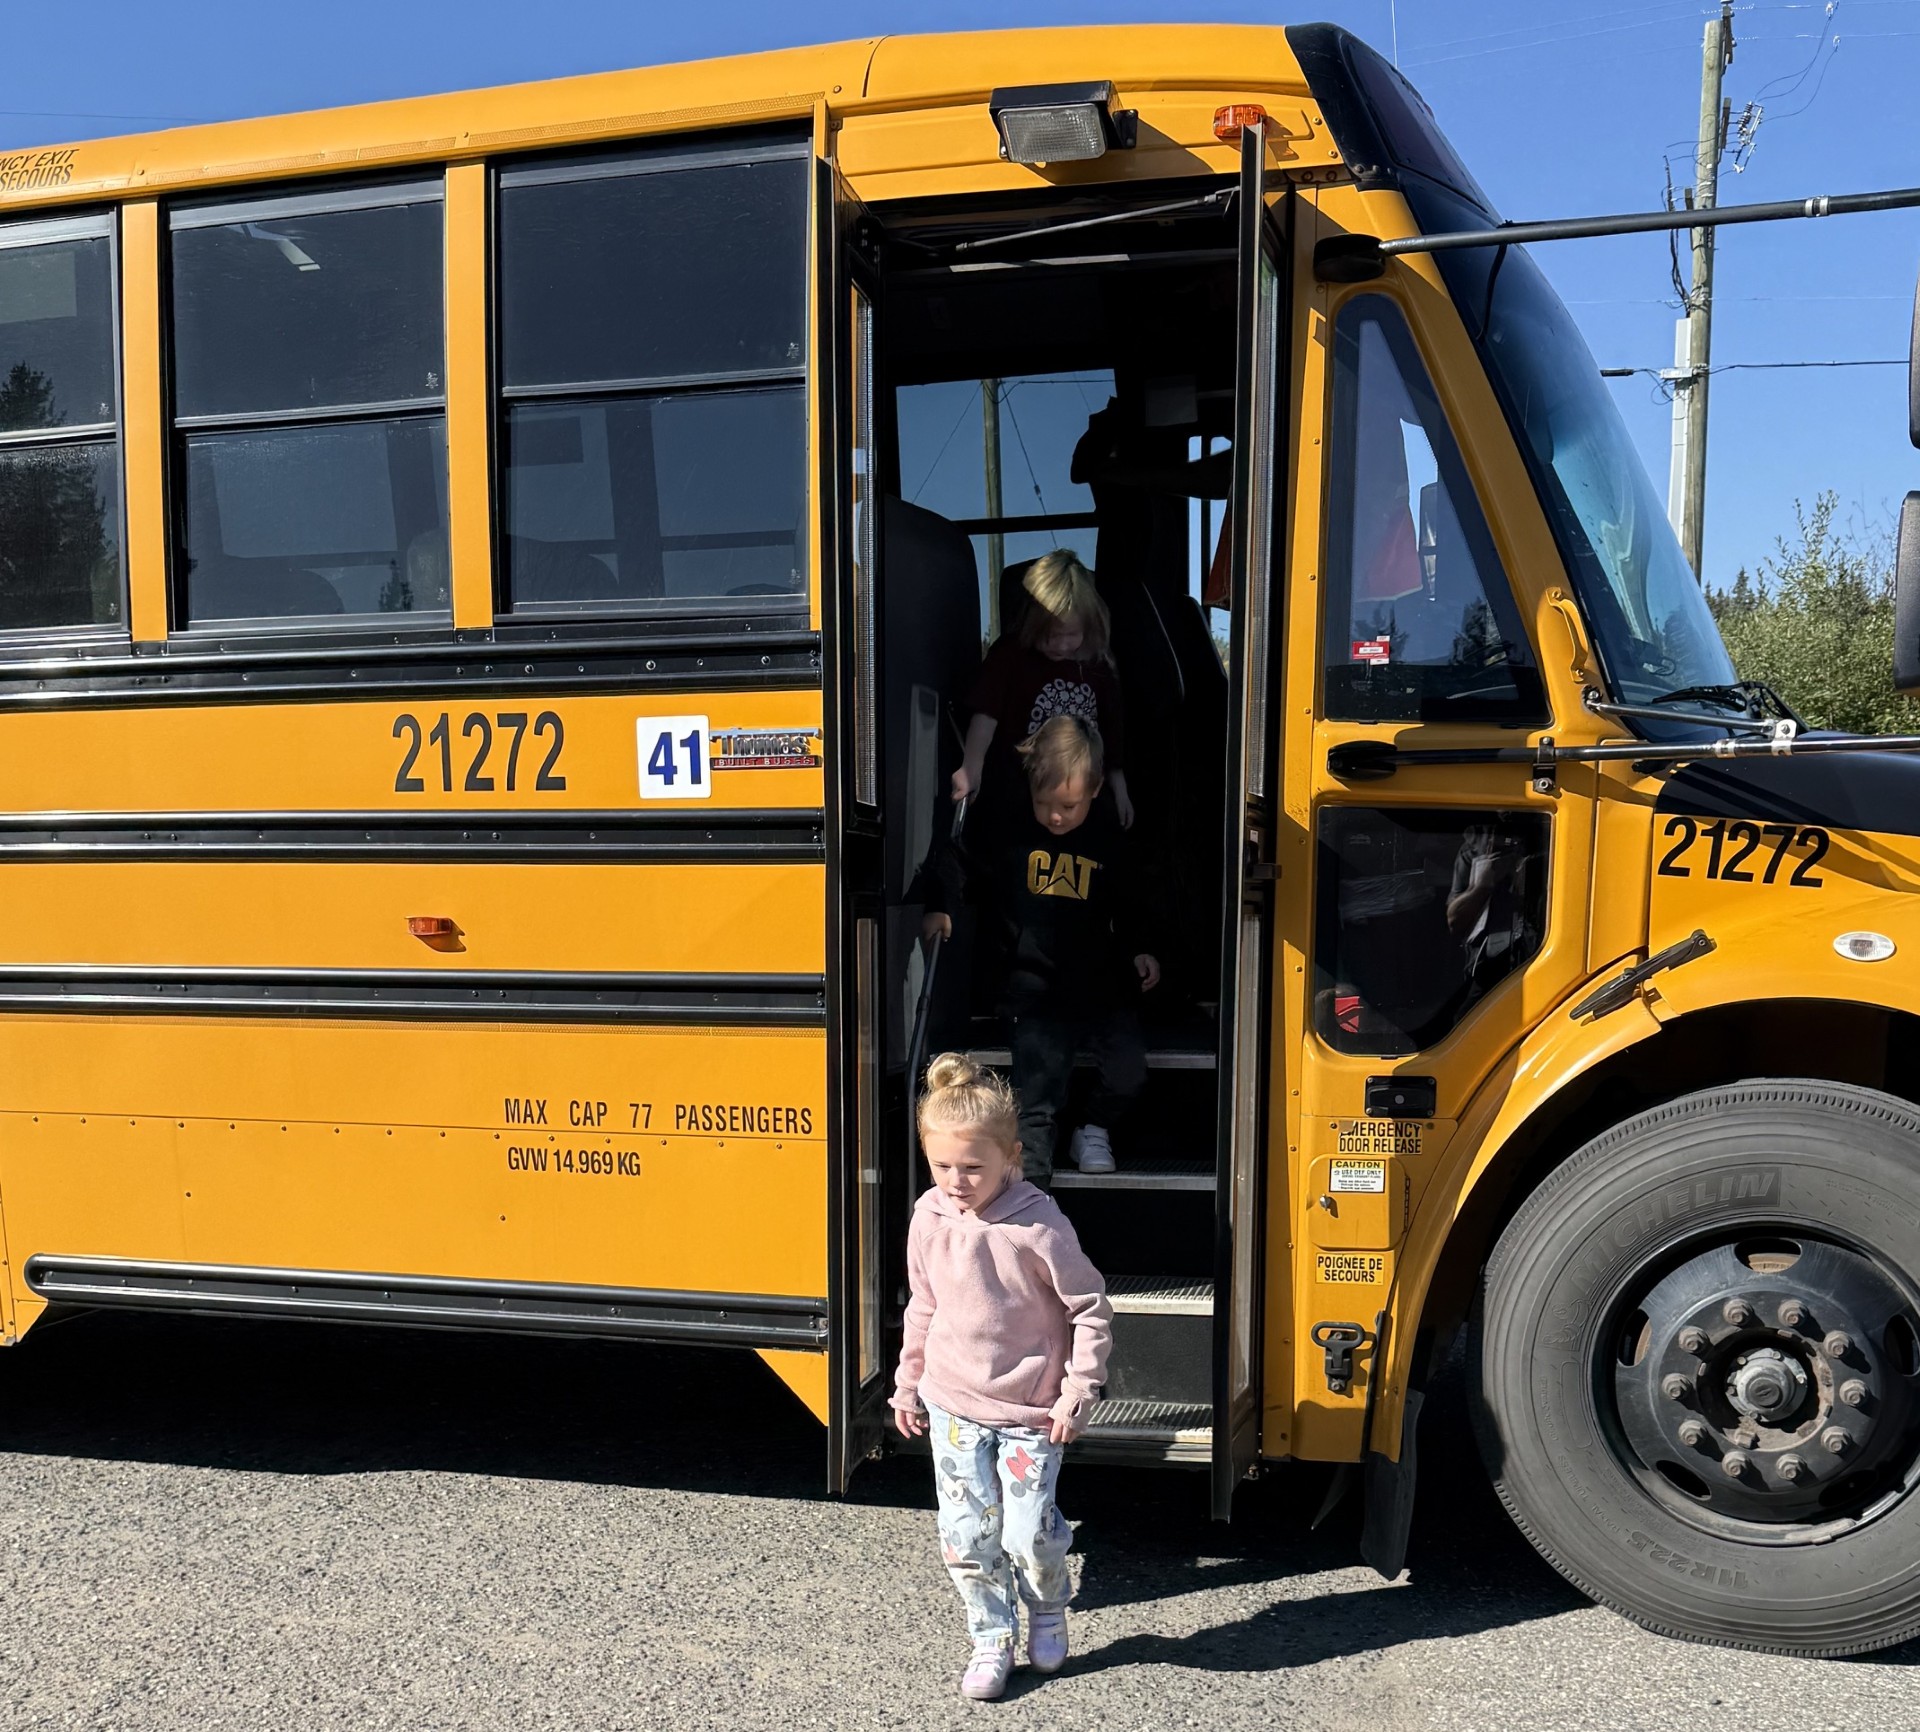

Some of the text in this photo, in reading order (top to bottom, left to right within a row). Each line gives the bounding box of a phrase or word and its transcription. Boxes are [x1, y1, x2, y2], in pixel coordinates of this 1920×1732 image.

[35, 149, 80, 167] EXIT
[392, 711, 566, 792] 21272
[648, 729, 701, 786] 41
[1657, 816, 1830, 888] 21272
[1027, 850, 1098, 900] CAT
[504, 1098, 813, 1135] MAX CAP 77 PASSENGERS
[1340, 1121, 1420, 1138] MERGENCY
[1339, 1138, 1421, 1153] DOOR RELEASE
[508, 1146, 641, 1176] GVW 14.969 KG
[1335, 1160, 1380, 1168] CAUTION
[1571, 1172, 1775, 1297] MICHELIN
[1324, 1269, 1375, 1282] SECOURS
[1368, 1258, 1383, 1270] DE
